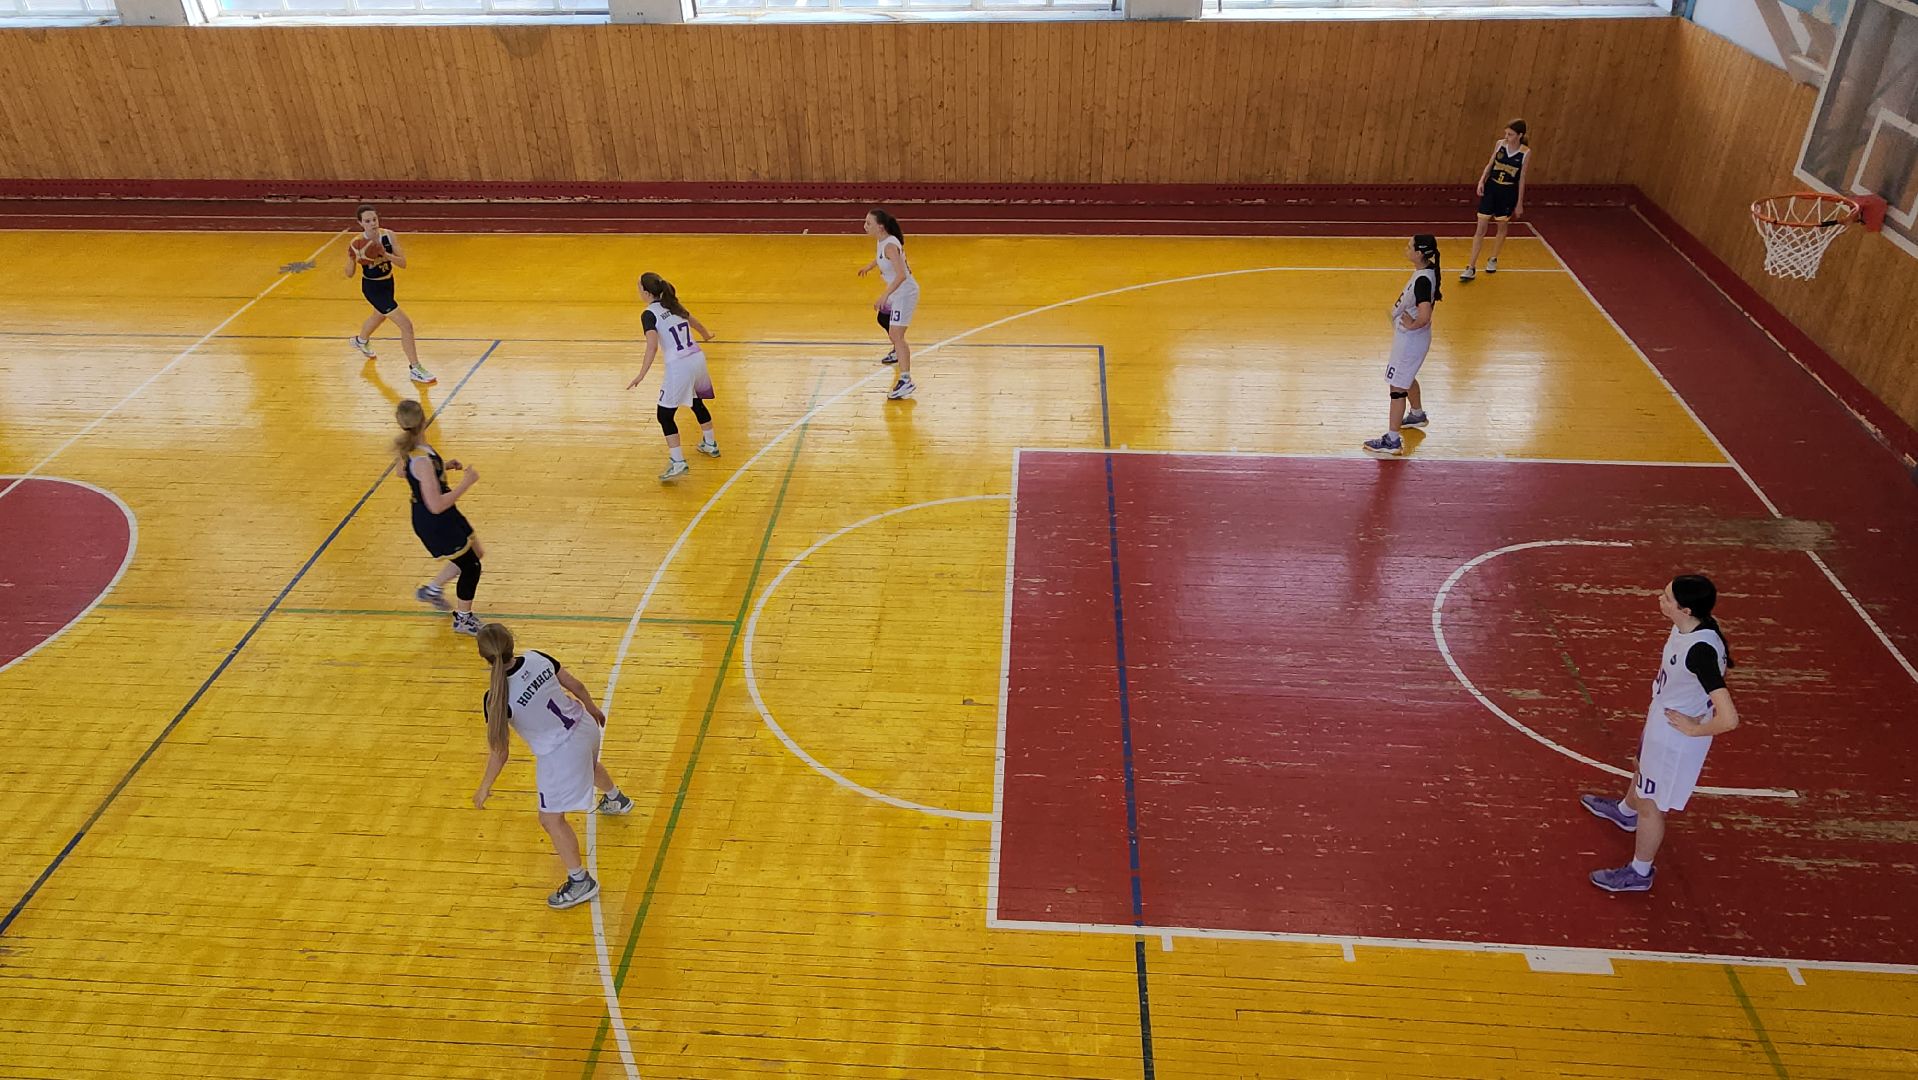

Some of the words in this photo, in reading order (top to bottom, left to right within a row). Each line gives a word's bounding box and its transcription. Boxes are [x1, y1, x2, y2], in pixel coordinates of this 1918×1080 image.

[669, 322, 693, 351] 17
[546, 698, 575, 730] 1
[540, 792, 546, 808] 1
